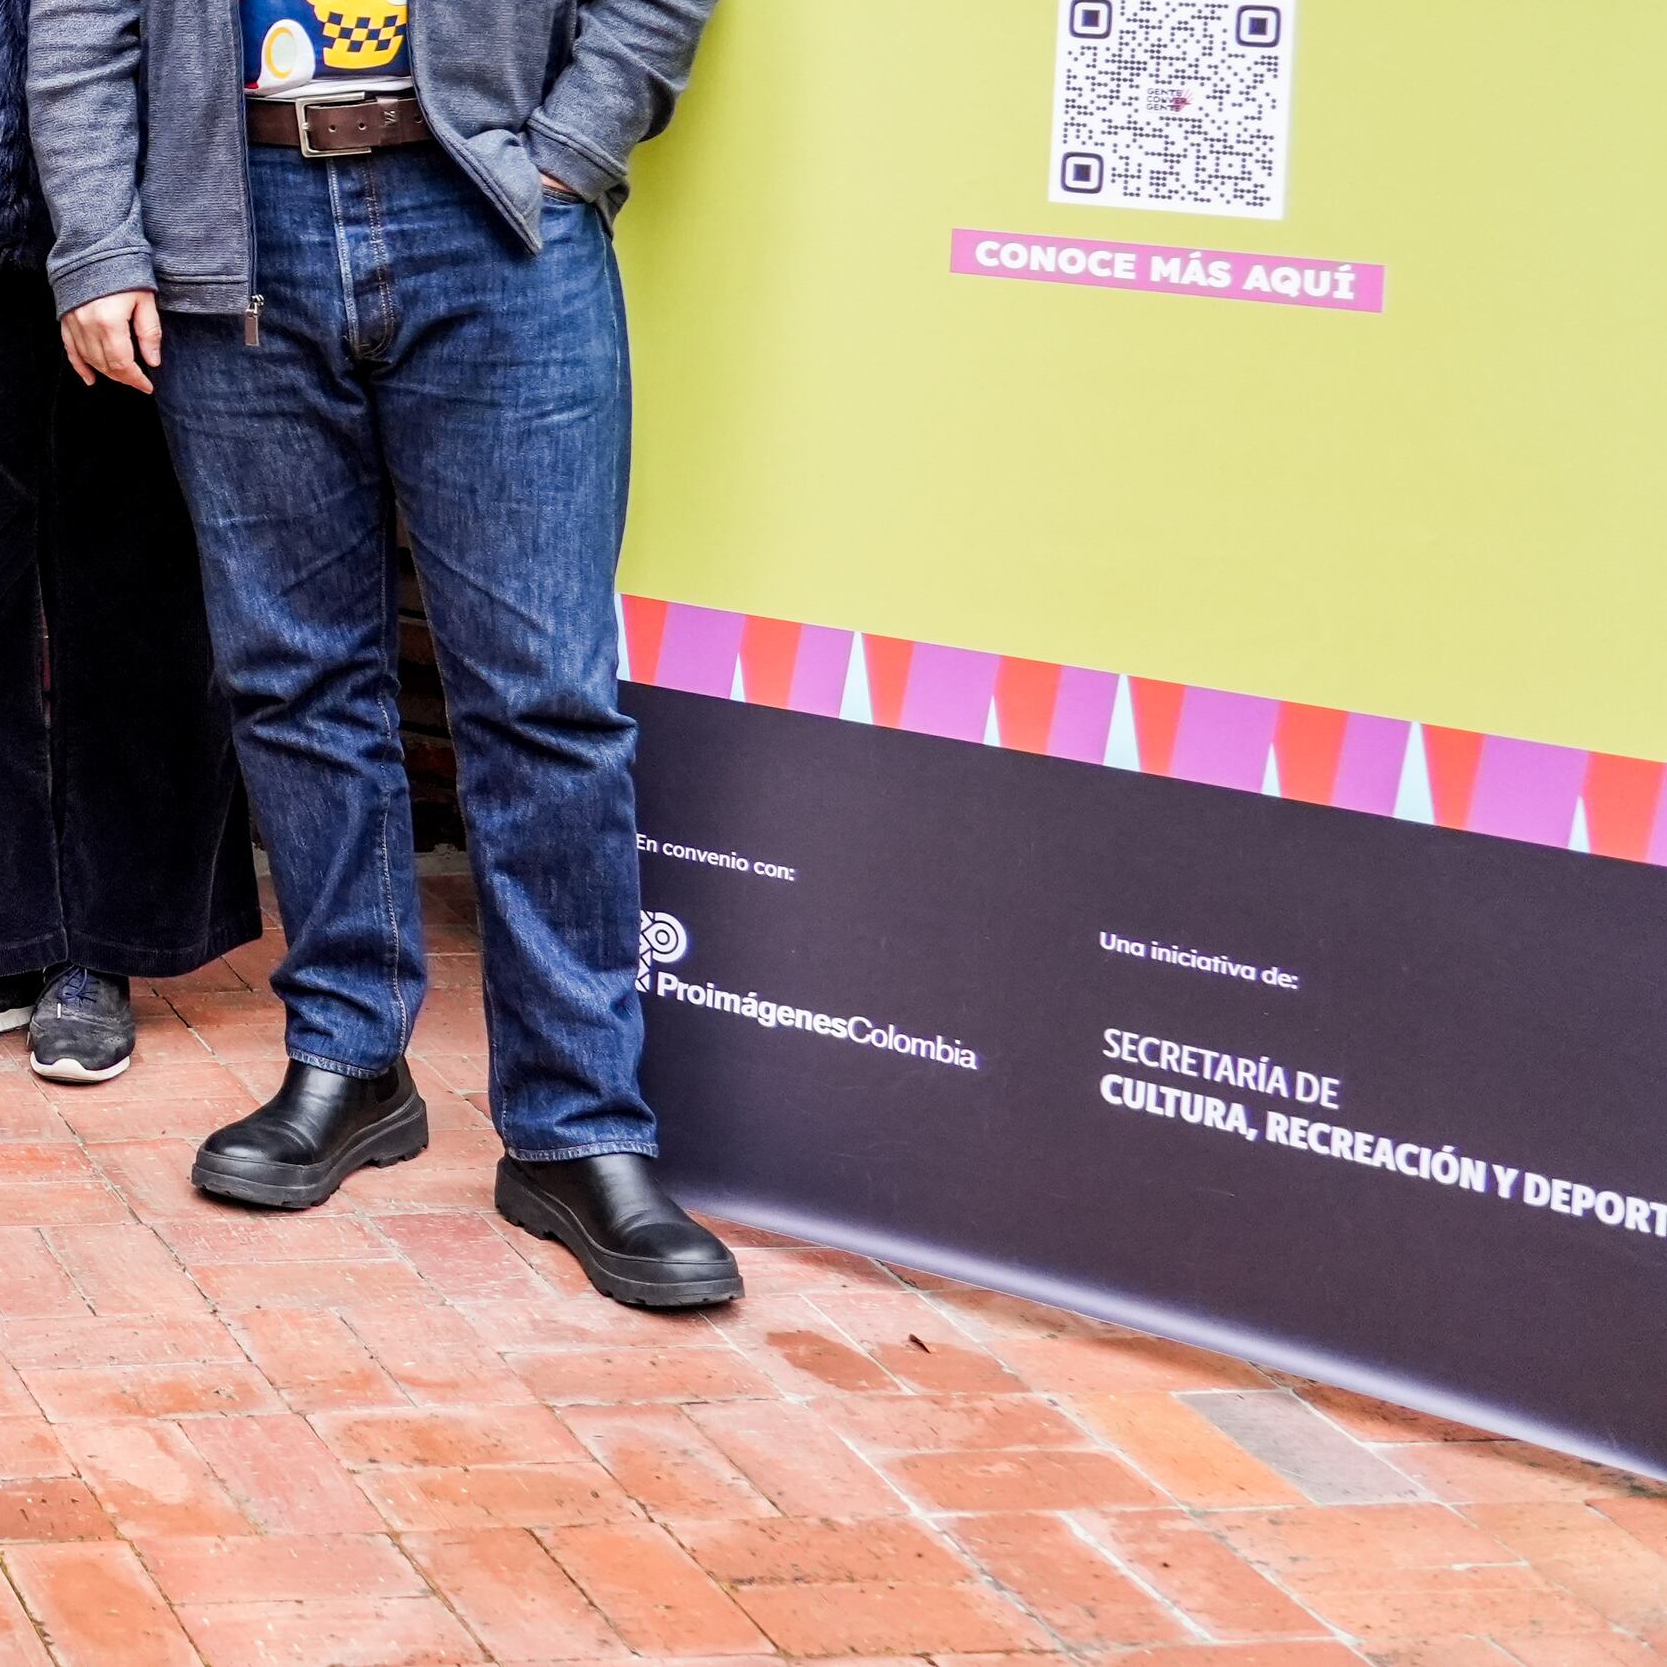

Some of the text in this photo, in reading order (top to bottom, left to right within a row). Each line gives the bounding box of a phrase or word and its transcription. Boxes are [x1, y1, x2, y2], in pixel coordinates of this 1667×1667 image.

[975, 240, 1357, 301] CONOCE MÁS AQUÍ
[636, 833, 795, 881] En convenio con:
[1099, 931, 1299, 990] Una iniciativa de:
[657, 971, 977, 1071] ProimágenesColombia
[1102, 1027, 1340, 1110] SECRETARÍA DE
[1099, 1073, 1258, 1141] CULTURA,
[1266, 1110, 1487, 1193] RECREACIÓN
[1492, 1163, 1520, 1199] Y
